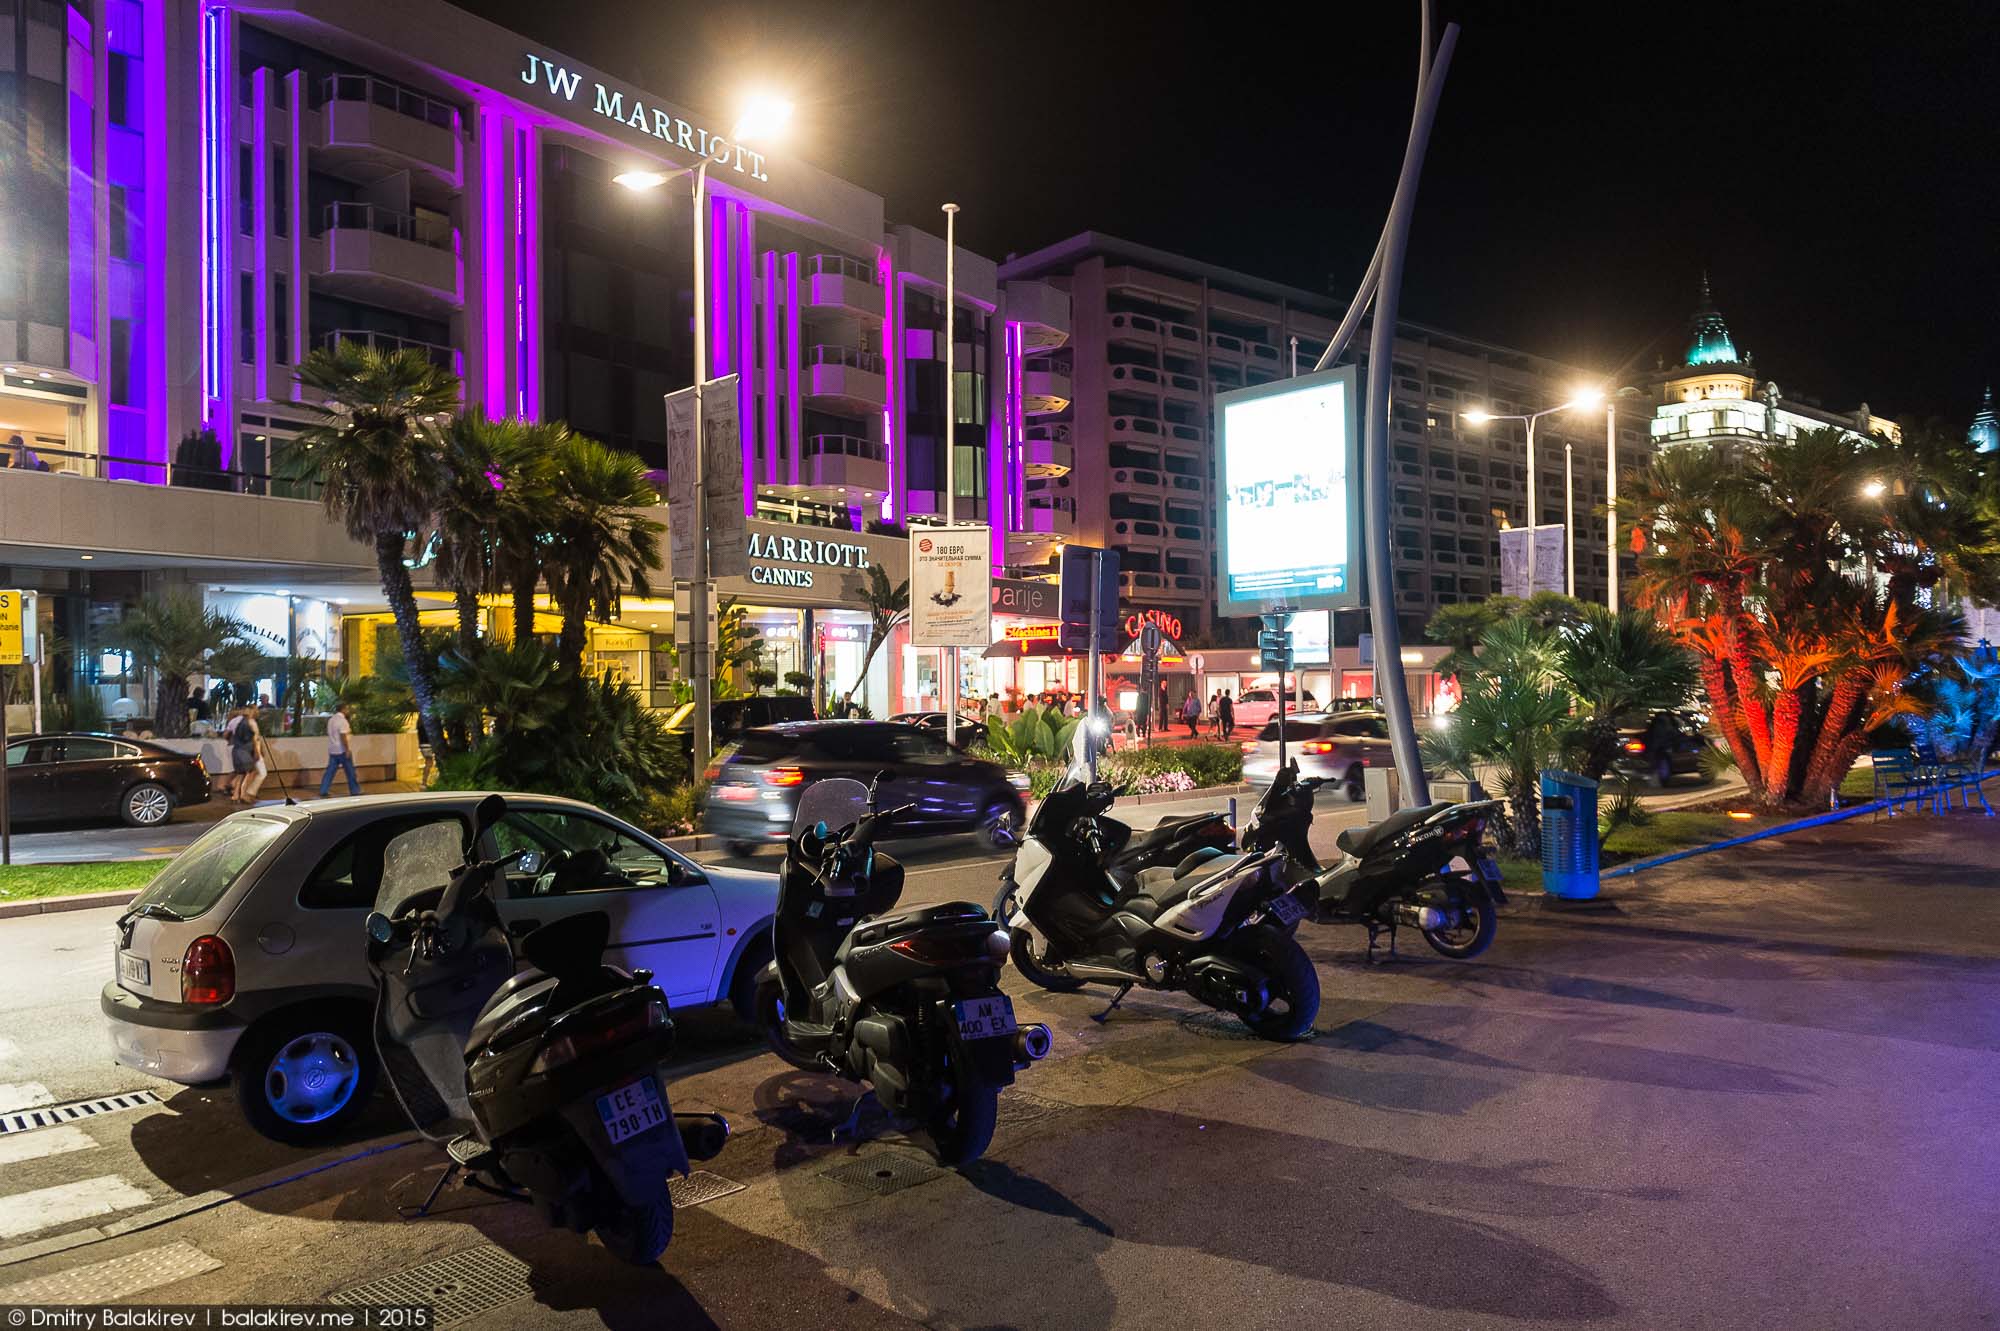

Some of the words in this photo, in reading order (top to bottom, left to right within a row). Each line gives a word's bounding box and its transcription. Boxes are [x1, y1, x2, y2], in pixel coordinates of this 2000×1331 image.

[521, 54, 582, 101] JW
[936, 546, 948, 555] 180
[750, 565, 814, 588] CANNES
[1002, 584, 1044, 613] arije
[1125, 608, 1183, 641] CASINO
